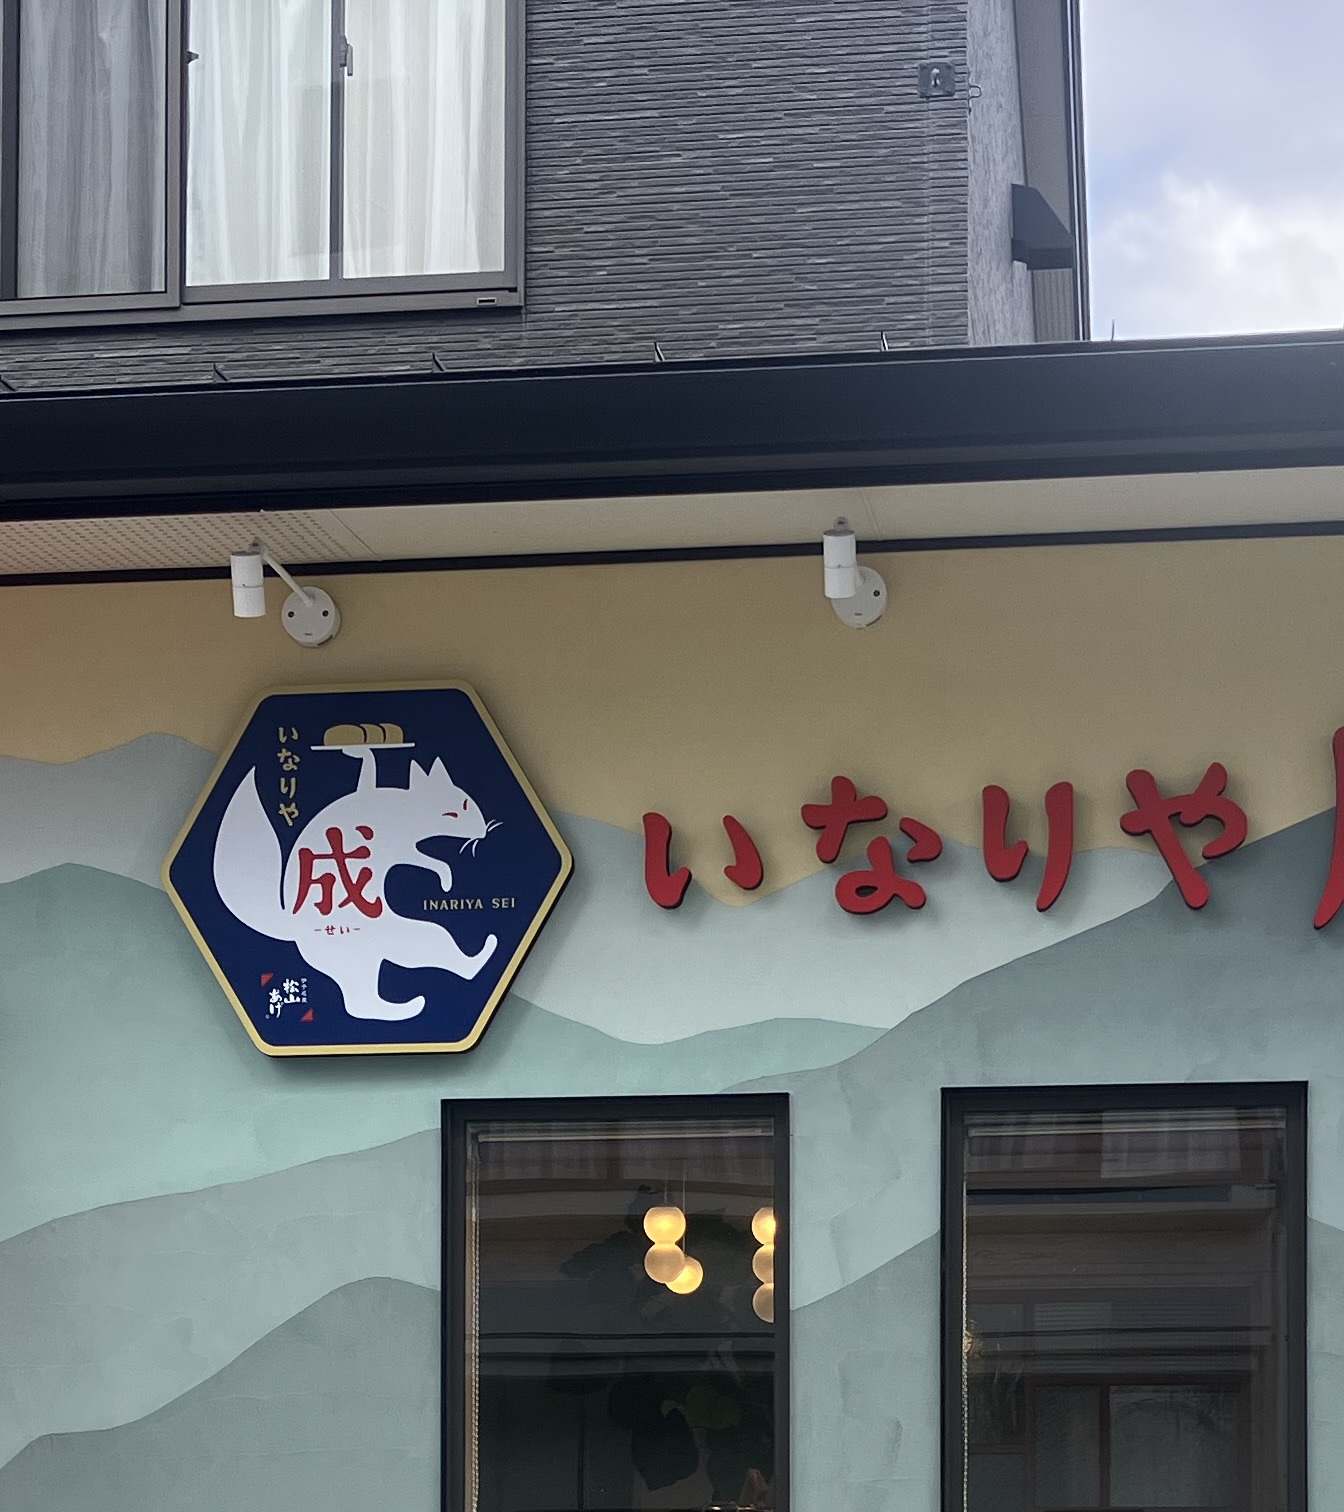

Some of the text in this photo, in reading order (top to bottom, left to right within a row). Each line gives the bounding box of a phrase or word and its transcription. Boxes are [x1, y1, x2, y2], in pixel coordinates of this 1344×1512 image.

[277, 727, 301, 826] いなりや
[292, 826, 383, 918] 成
[423, 897, 515, 911] INARIYA SEI
